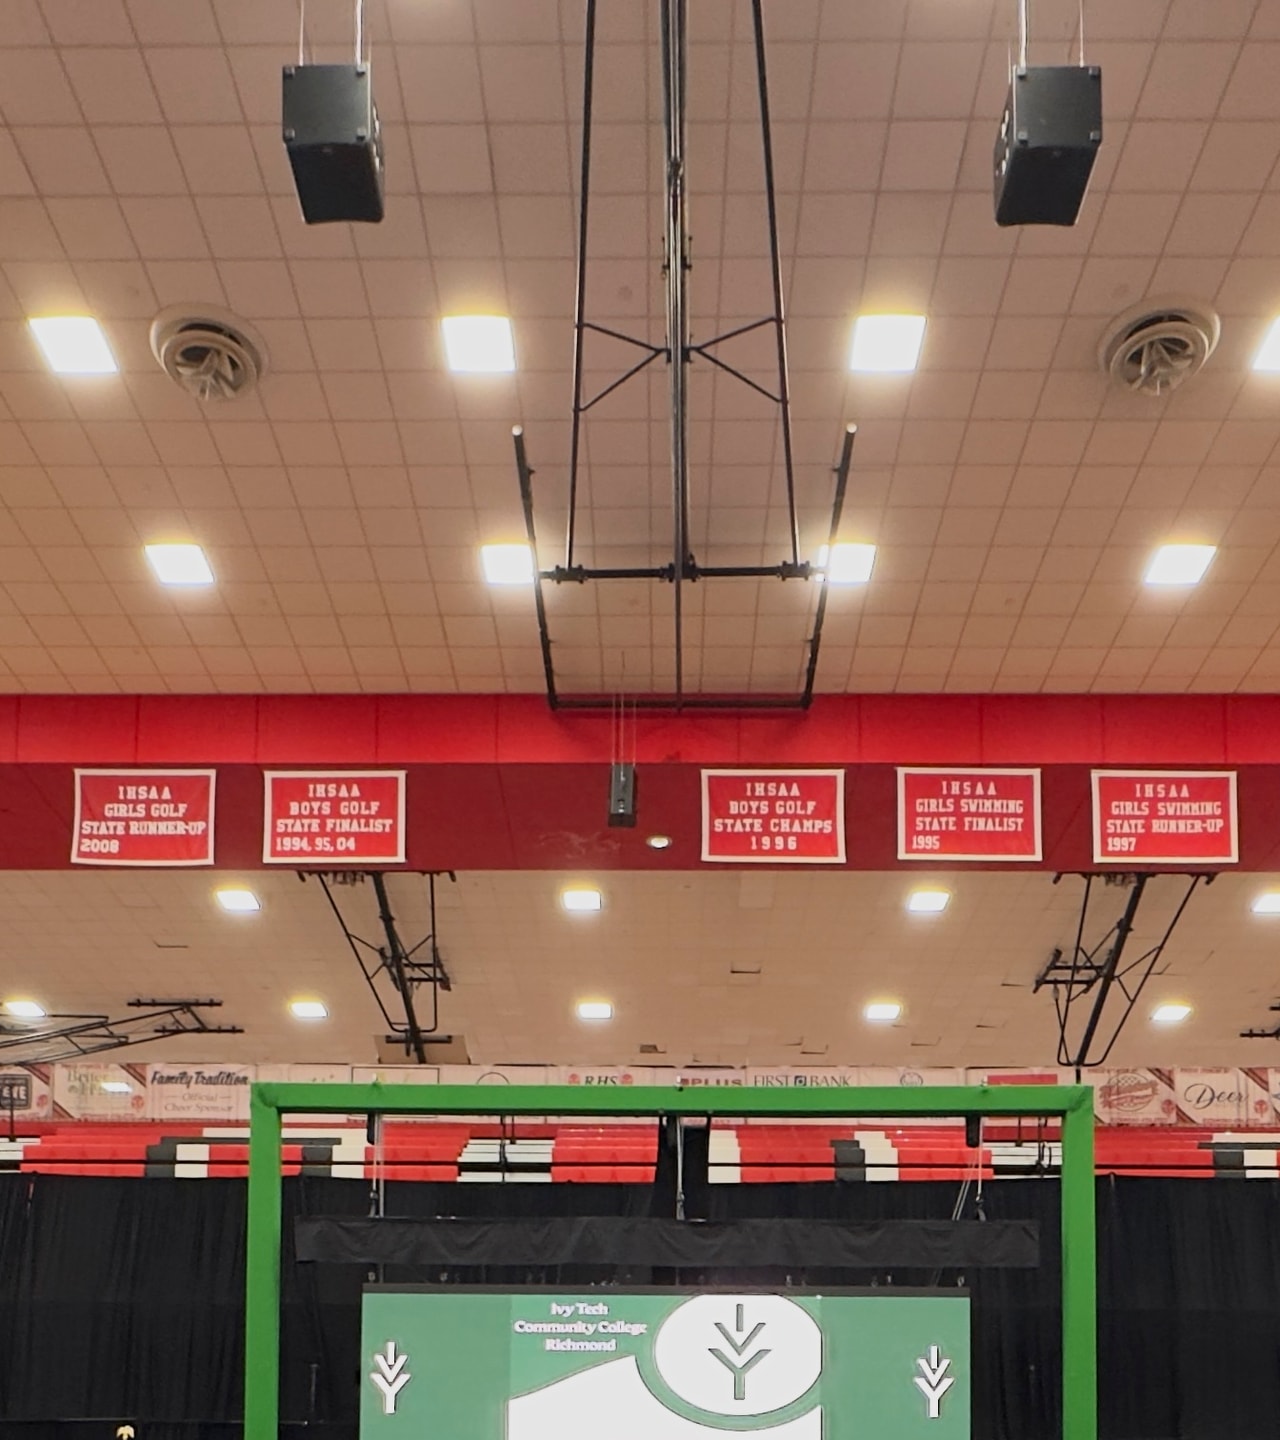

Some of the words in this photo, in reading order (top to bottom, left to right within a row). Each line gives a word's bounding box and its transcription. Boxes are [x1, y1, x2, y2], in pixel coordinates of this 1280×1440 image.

[118, 785, 172, 800] IHSAA
[308, 783, 361, 798] IHSAA
[746, 782, 801, 796] IHSAA
[941, 781, 997, 796] IHSAA
[1135, 783, 1190, 798] IHSAA
[104, 803, 146, 818] GIRLS
[150, 803, 188, 818] GOLF
[289, 801, 331, 816] BOYS
[339, 801, 380, 816] GOLF
[729, 801, 769, 815] BOYS
[775, 801, 817, 815] GOLF
[915, 798, 954, 813] GIRLS
[960, 799, 1024, 814] SWIMMING
[1111, 801, 1150, 816] GIRLS
[1157, 801, 1222, 816] SWIMMING
[81, 821, 126, 835] STATE
[129, 821, 207, 835] RUNNER-UP
[276, 818, 321, 833] STATE
[325, 818, 393, 833] FINALIST
[714, 818, 763, 833] STATE
[770, 818, 832, 834] CHAMPS
[915, 816, 957, 831] STATE
[963, 816, 1024, 832] FINALIST
[1106, 819, 1146, 834] STATE
[1151, 819, 1224, 834] RUNNER-UP
[80, 838, 120, 854] 2008
[336, 836, 356, 851] 04
[750, 835, 798, 850] 1996
[912, 835, 941, 850] 1995
[1107, 836, 1137, 852] 1997
[151, 1071, 193, 1089] Family
[195, 1071, 249, 1086] Tradition
[584, 1075, 619, 1086] RHS
[753, 1075, 792, 1087] FIRST
[809, 1075, 852, 1087] BANK
[551, 1302, 575, 1317] Ivy
[576, 1302, 608, 1315] Tech
[514, 1320, 597, 1335] Community
[598, 1320, 647, 1335] College
[545, 1338, 617, 1351] Richmond
